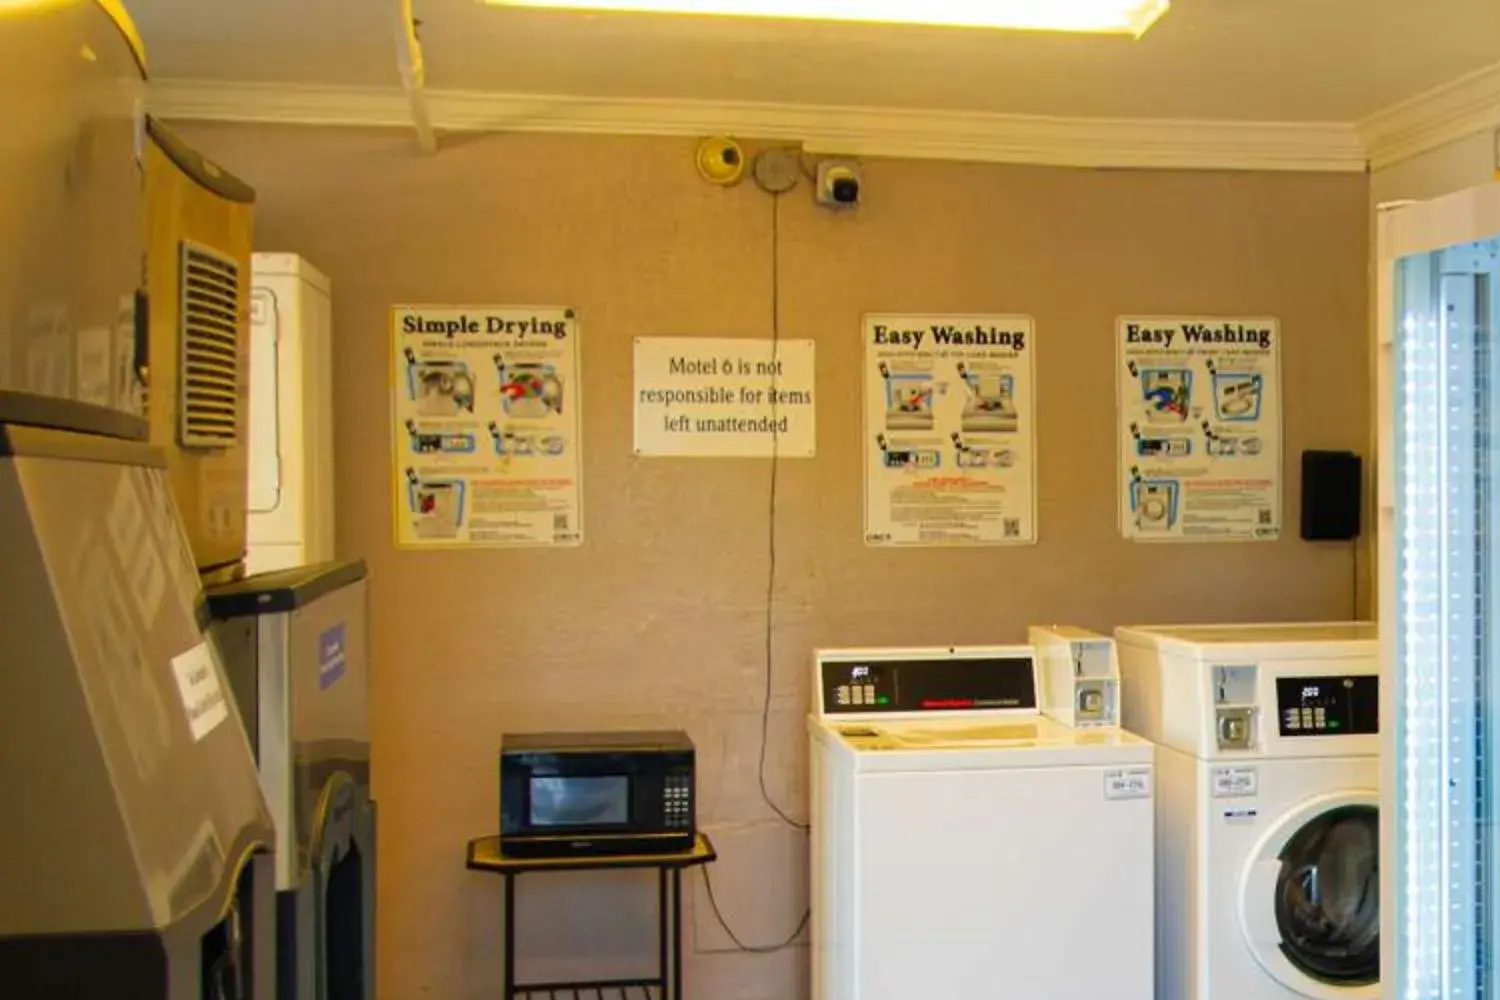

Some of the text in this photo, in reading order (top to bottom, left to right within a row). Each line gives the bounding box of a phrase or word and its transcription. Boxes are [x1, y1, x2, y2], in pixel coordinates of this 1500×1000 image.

[403, 315, 567, 340] Simple Drying
[873, 325, 1026, 350] Easy Washing
[1127, 324, 1271, 349] Easy Washing
[669, 357, 783, 376] Motel 6 is not
[639, 385, 812, 407] responsible for items
[664, 414, 788, 434] left unattended
